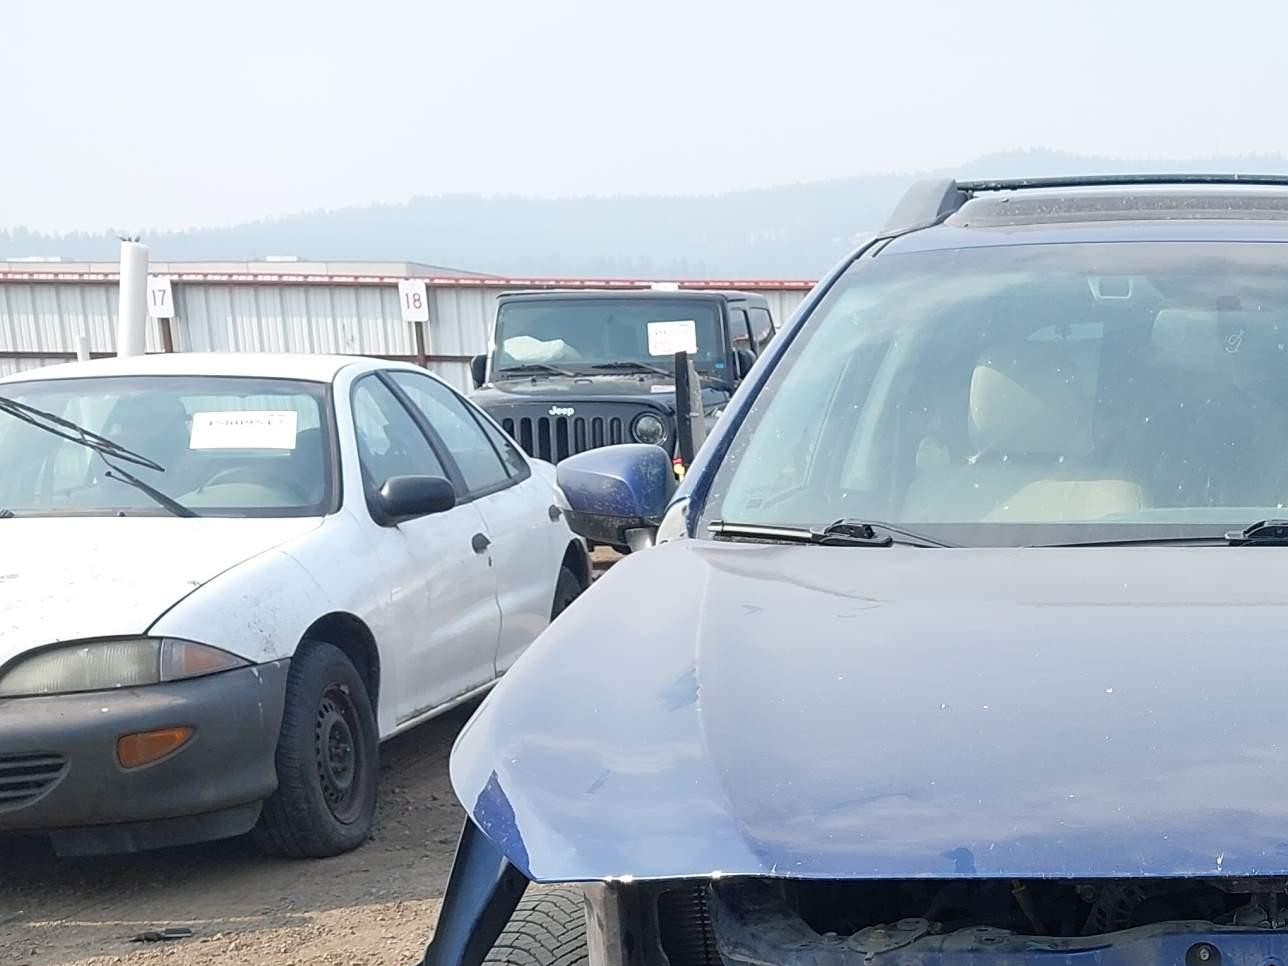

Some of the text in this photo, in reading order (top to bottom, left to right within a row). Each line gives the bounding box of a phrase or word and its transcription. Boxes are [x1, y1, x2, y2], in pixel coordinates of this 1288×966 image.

[152, 289, 166, 306] 17
[405, 292, 422, 310] 18
[548, 405, 575, 417] Jeep
